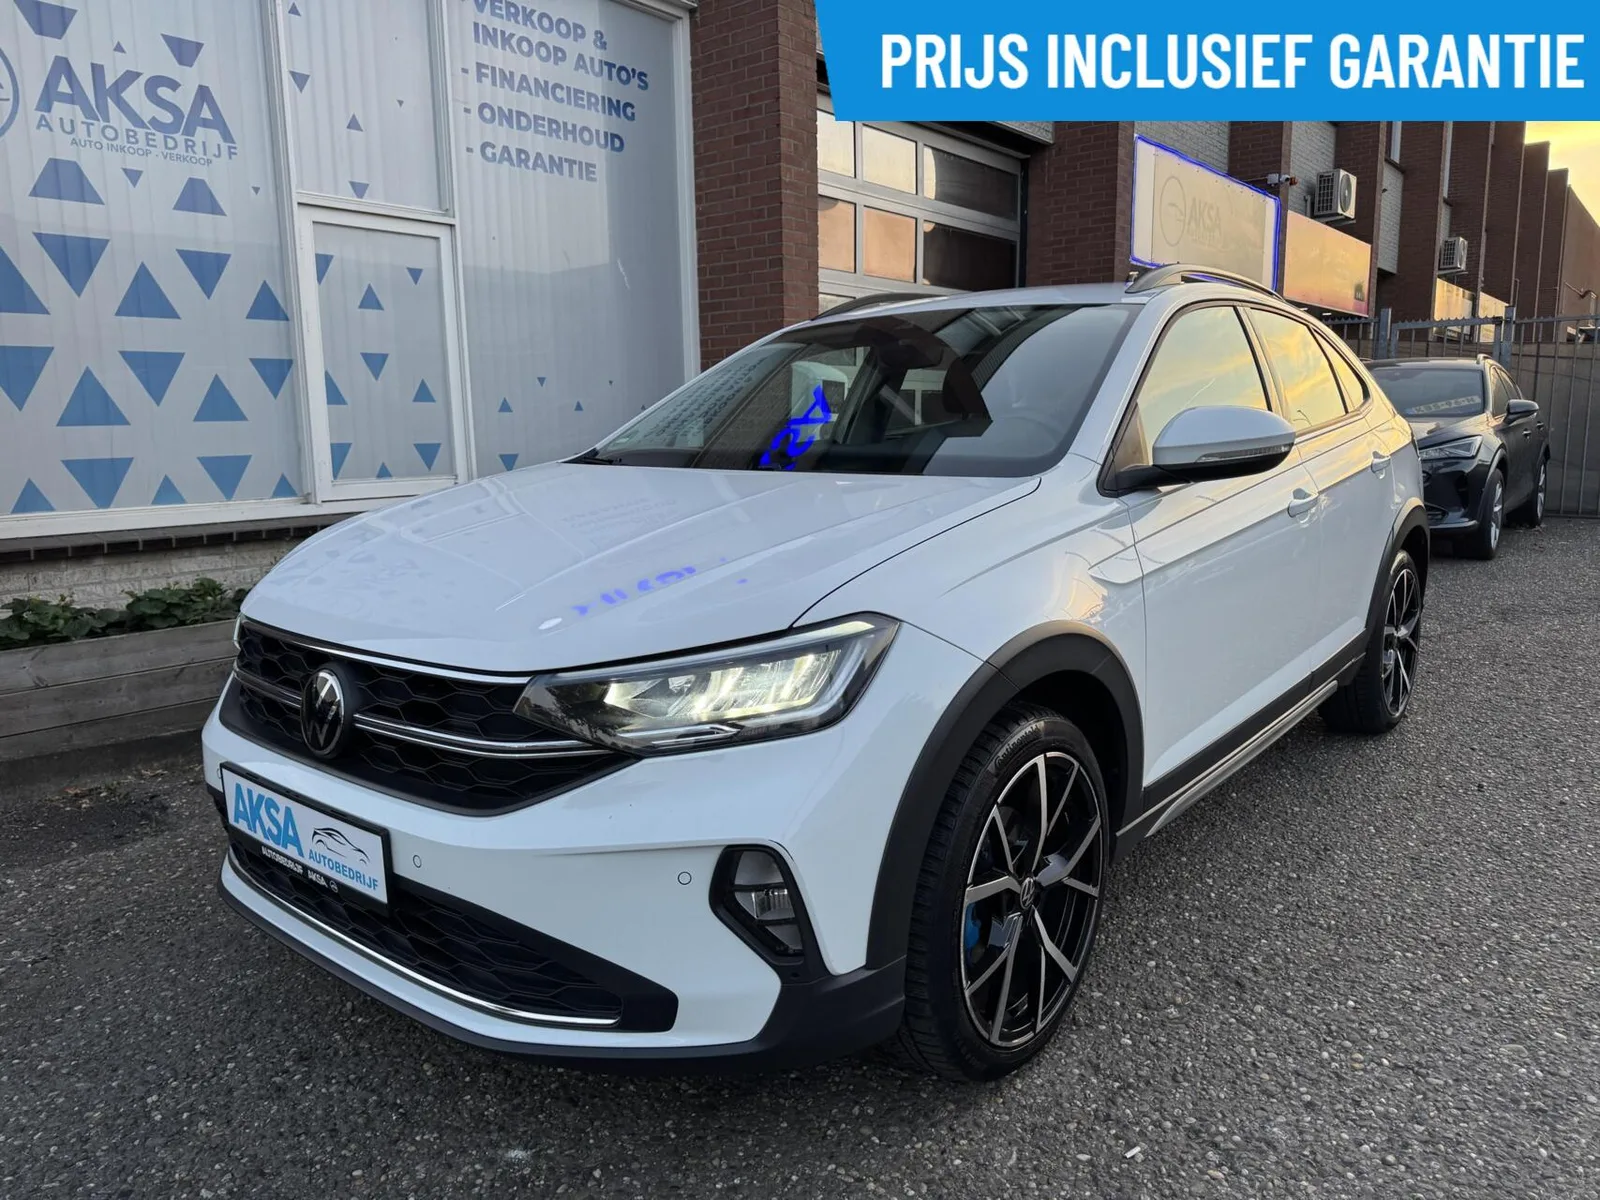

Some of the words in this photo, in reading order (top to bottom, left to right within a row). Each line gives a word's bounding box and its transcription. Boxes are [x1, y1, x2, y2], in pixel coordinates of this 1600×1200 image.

[473, 0, 587, 42] VERKOOP
[593, 29, 608, 50] &
[473, 21, 567, 66] INKOOP
[573, 53, 649, 91] AUTO'S
[34, 55, 236, 144] AKSA
[475, 62, 636, 122] FINANCIERING
[36, 114, 238, 160] AUTOBEDRIJF
[70, 137, 104, 151] AUTO
[106, 142, 152, 157] INKOOP
[161, 150, 213, 167] VERKOOP
[478, 102, 625, 153] ONDERHOUD
[480, 141, 598, 182] GARANTIE
[233, 782, 304, 858] AKSA
[307, 870, 328, 888] AKSA
[308, 849, 379, 891] AUTOBEDRIJF
